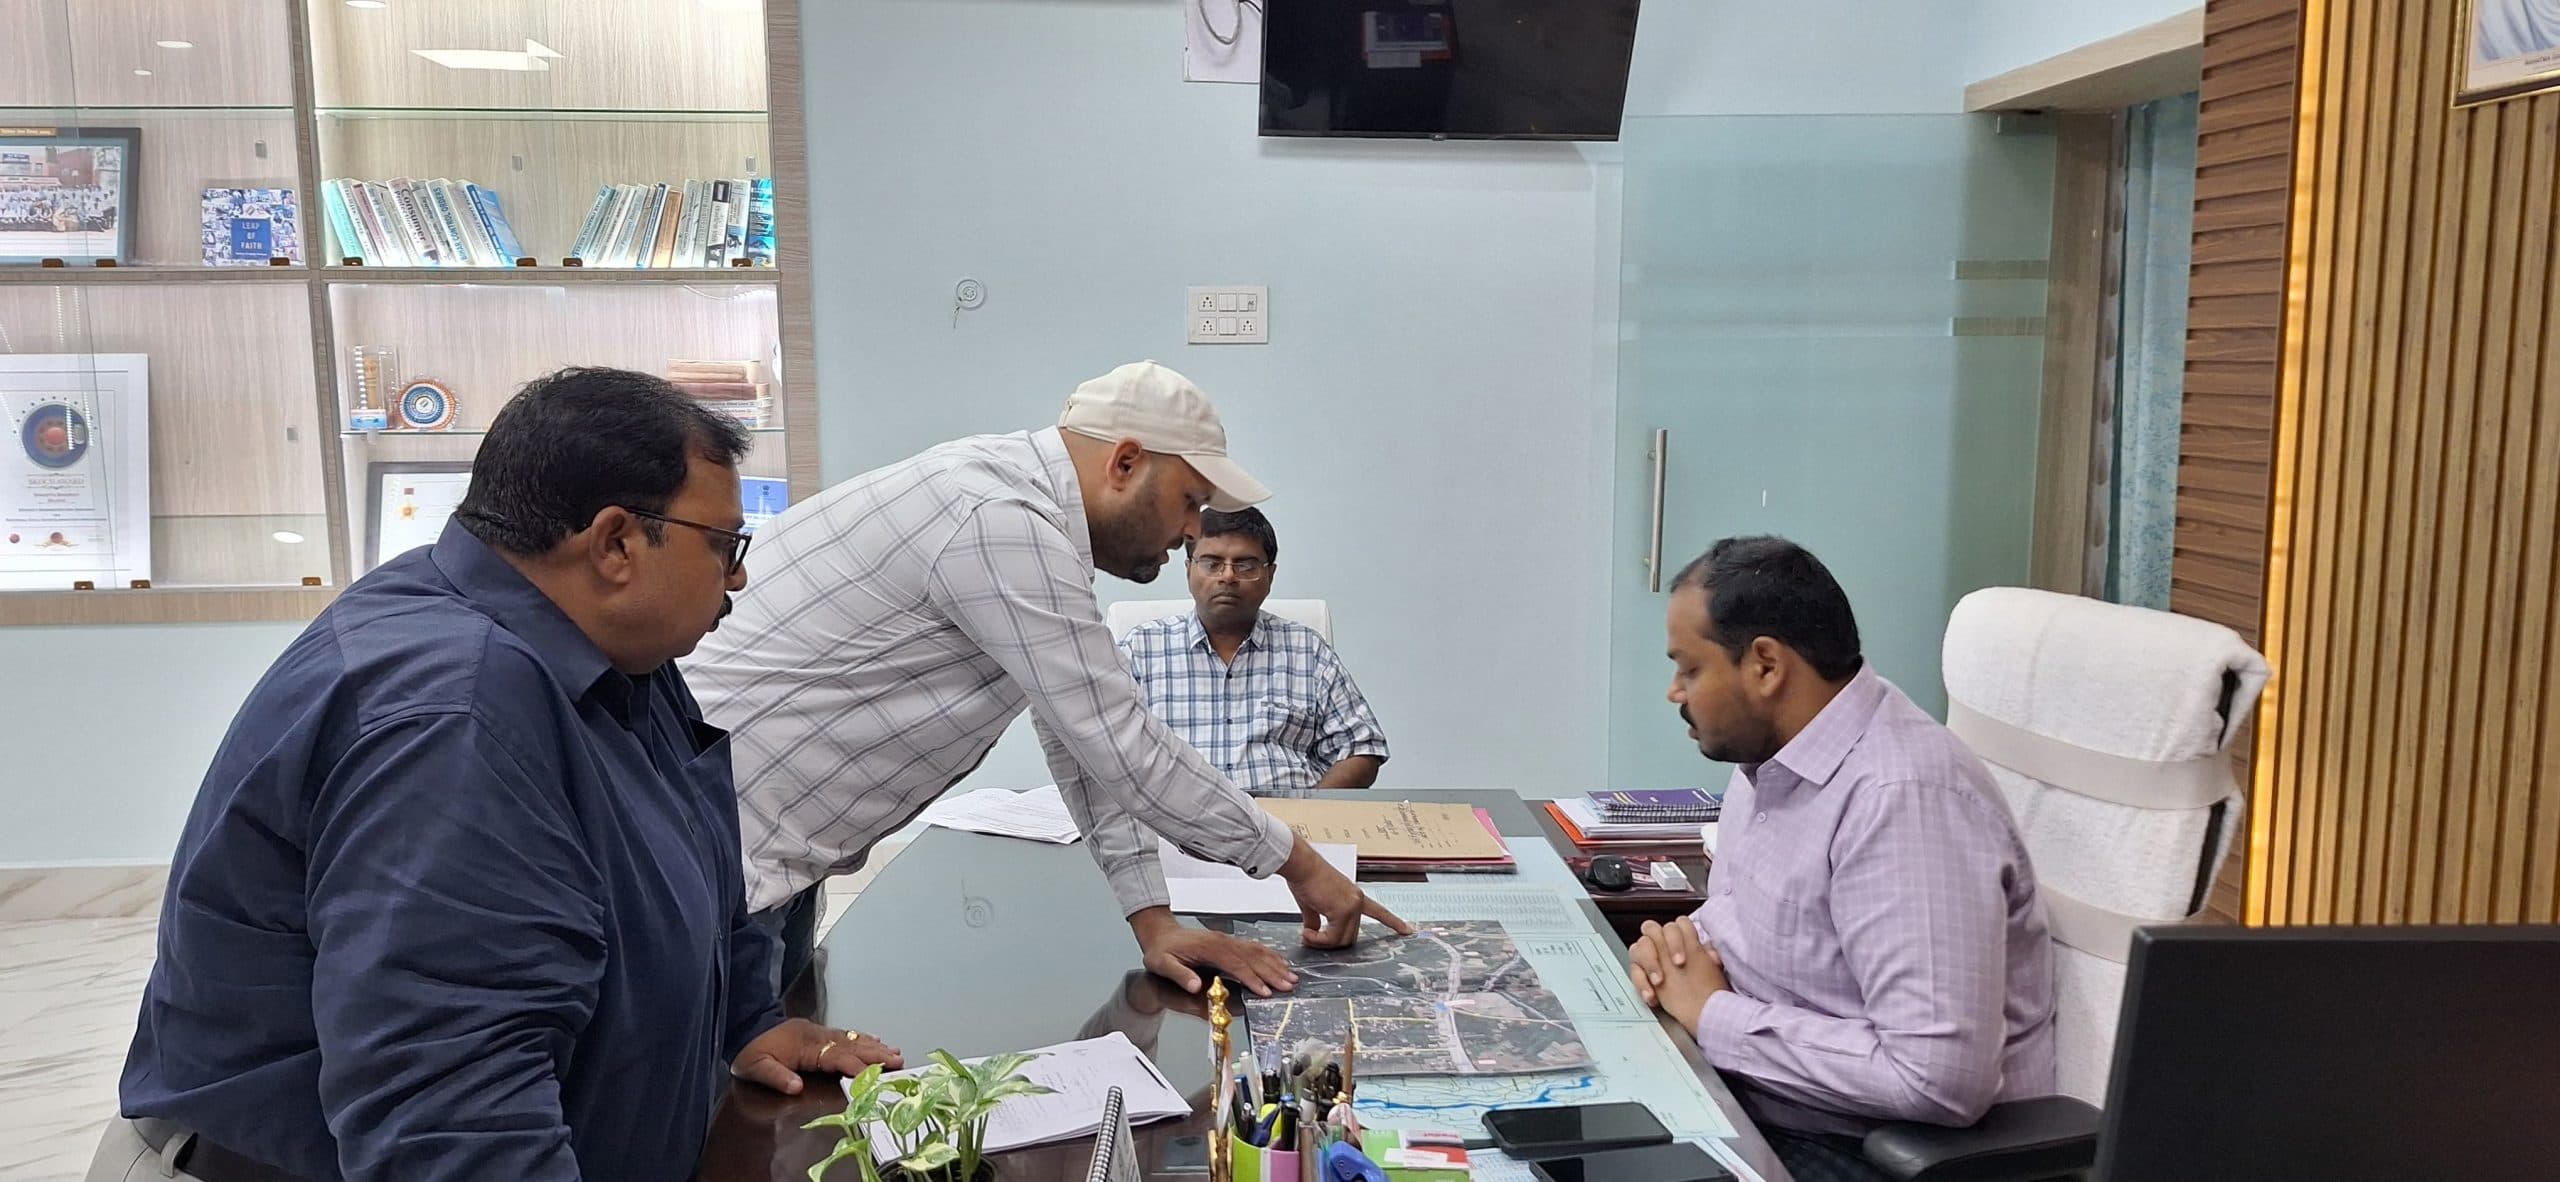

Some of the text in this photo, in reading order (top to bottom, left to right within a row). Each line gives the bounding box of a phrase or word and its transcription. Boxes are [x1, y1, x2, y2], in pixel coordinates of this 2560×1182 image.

[432, 187, 448, 212] ORDERS
[399, 188, 427, 242] Consumer
[442, 212, 459, 241] CONTROL
[240, 241, 262, 250] FAITH
